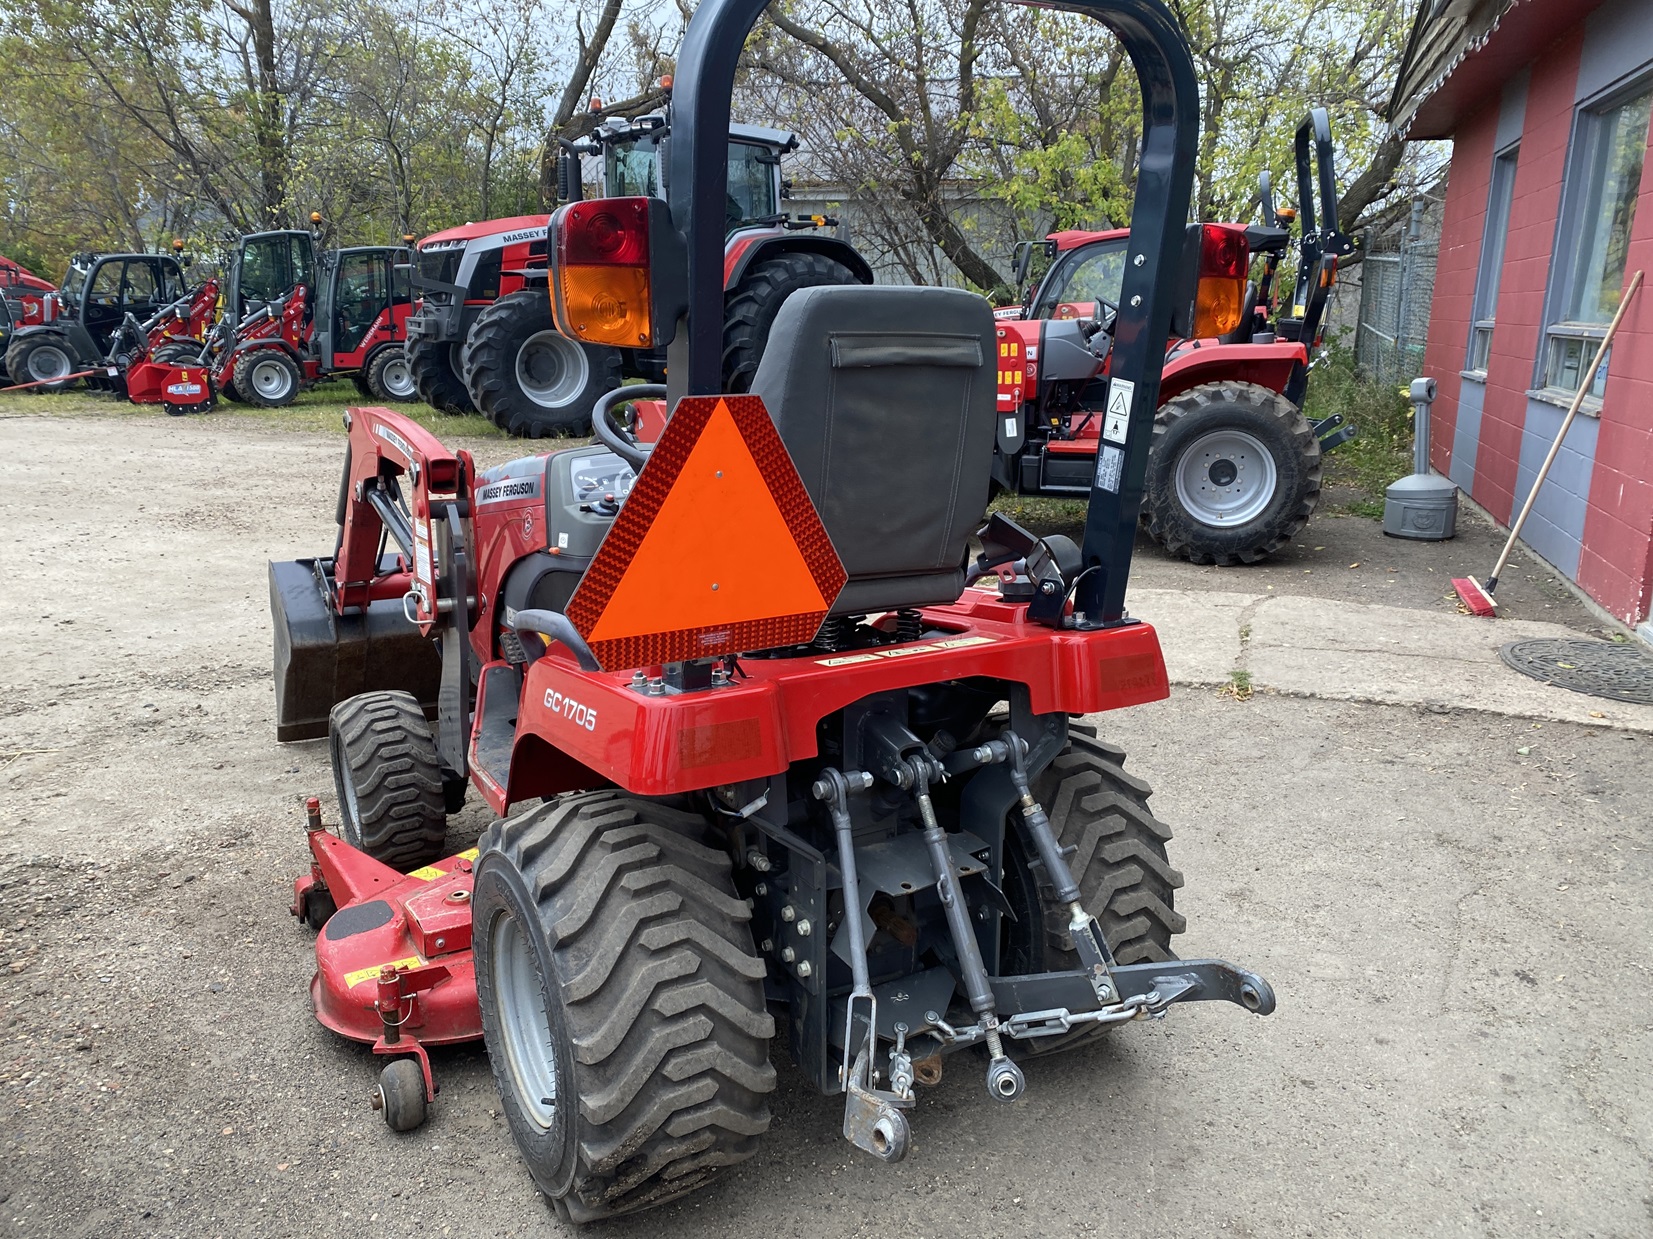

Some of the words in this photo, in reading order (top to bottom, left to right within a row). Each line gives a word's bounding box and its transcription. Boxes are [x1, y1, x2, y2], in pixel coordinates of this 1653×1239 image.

[503, 231, 540, 243] MASSEY
[359, 315, 383, 348] WEIDEMANN
[483, 486, 503, 501] MASSEY
[503, 482, 535, 497] FERGUSON
[544, 688, 597, 731] GC1705
